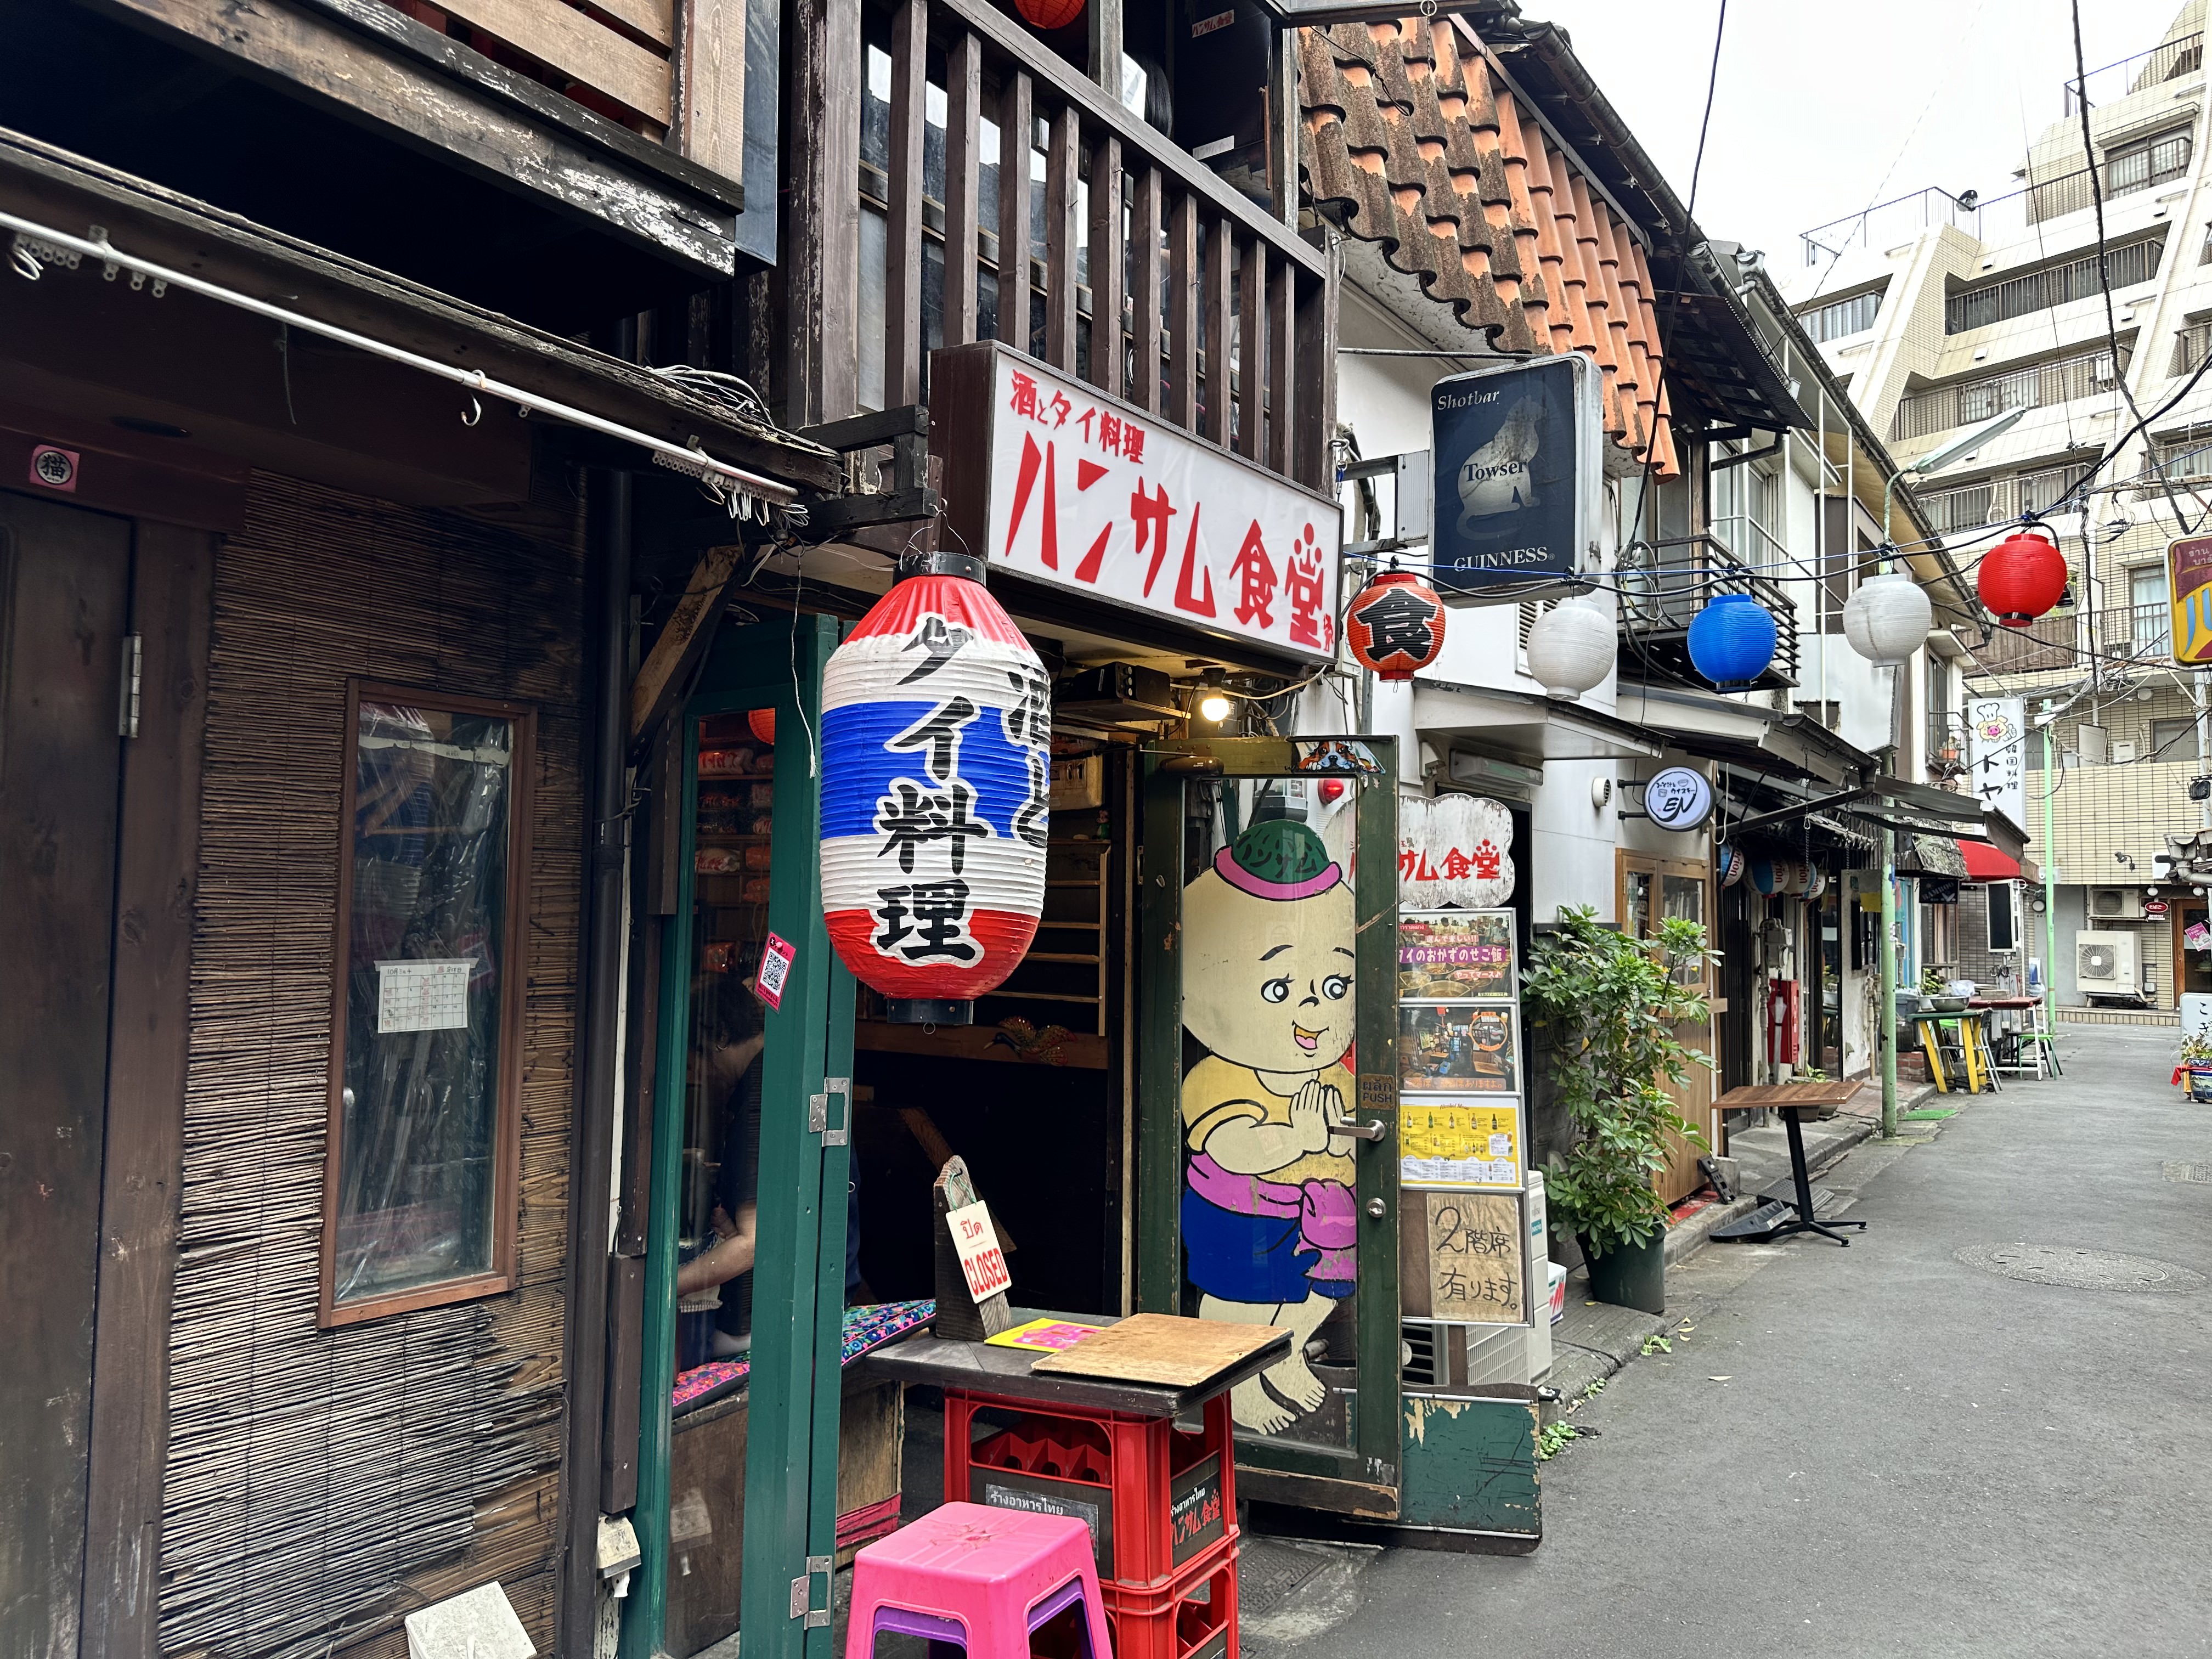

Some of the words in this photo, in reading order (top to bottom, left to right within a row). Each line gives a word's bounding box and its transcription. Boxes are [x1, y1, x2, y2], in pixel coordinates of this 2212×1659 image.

[1010, 369, 1145, 464] 酒とタイ料理
[1437, 388, 1500, 411] Shotbar
[1463, 460, 1526, 483] Towser
[1005, 430, 1324, 650] ハンサム食堂
[1453, 546, 1548, 572] GUINNESS
[1356, 589, 1438, 662] 食
[877, 617, 988, 961] タイ料理
[1363, 1092, 1392, 1102] PUSH
[960, 1218, 984, 1239] ปิด
[1435, 1206, 1511, 1258] 2階席
[964, 1248, 1008, 1296] CLOSED
[1438, 1267, 1517, 1311] 有ります。
